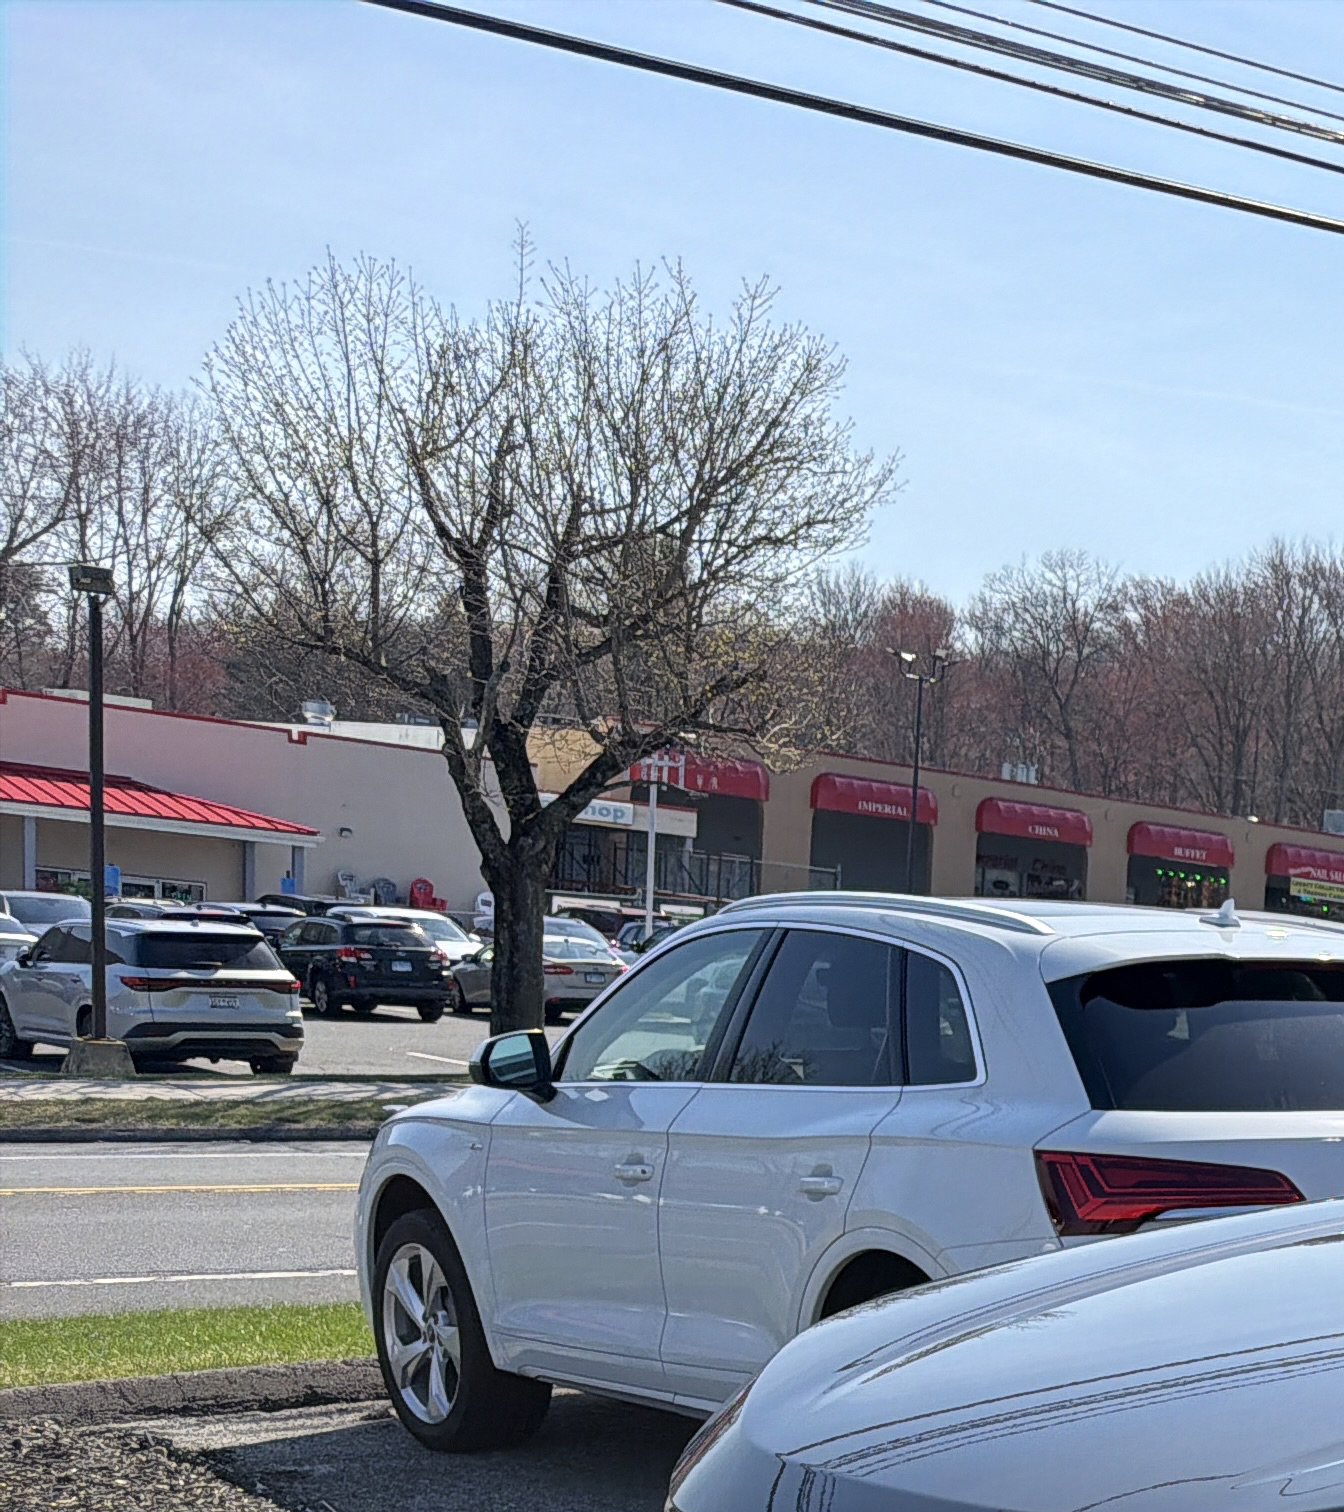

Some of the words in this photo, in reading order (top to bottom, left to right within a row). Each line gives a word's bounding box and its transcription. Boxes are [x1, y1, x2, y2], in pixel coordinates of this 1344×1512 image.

[858, 800, 910, 816] IMPERIAL
[1028, 824, 1059, 837] CHINA
[1309, 867, 1328, 880] NAIL
